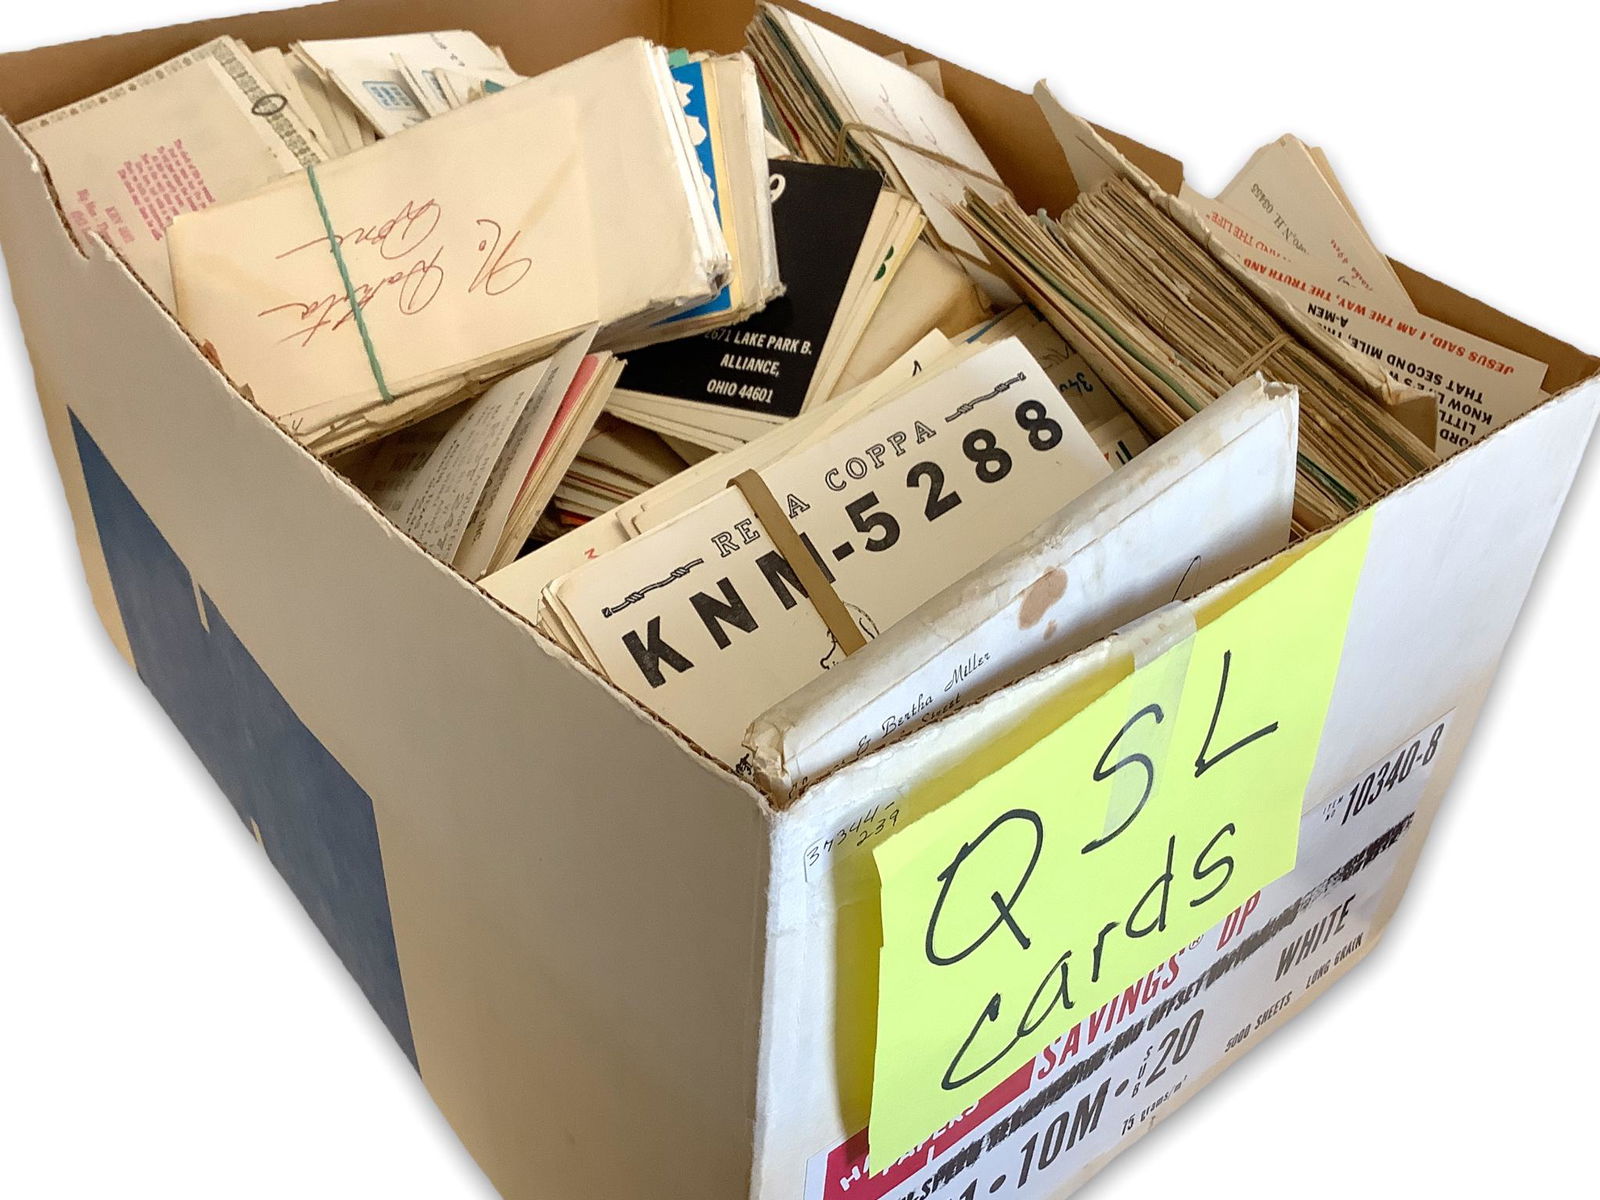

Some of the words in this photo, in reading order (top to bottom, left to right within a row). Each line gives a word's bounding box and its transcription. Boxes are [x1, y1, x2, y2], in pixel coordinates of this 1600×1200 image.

[1233, 225, 1254, 246] THE
[1243, 258, 1268, 275] AND
[1268, 269, 1306, 293] TRUTH
[1311, 284, 1332, 300] THE
[1307, 303, 1349, 327] A-MEN
[1336, 295, 1366, 317] WAY,
[1369, 311, 1395, 327] THE
[1396, 320, 1417, 337] AM
[734, 331, 767, 348] LAKE
[766, 335, 800, 353] PARK
[800, 340, 813, 356] B.
[1348, 334, 1384, 359] MILE,
[1430, 332, 1466, 357] SAID,
[720, 353, 780, 377] ALLIANCE,
[1387, 354, 1443, 386] SECOND
[1467, 352, 1514, 375] JESUS
[706, 378, 738, 397] OHIO
[738, 384, 774, 404] 44601
[1446, 379, 1484, 404] THAT
[1448, 397, 1493, 426] KNOW
[711, 493, 811, 560] REA
[824, 419, 937, 493] COPPA
[881, 695, 934, 738] Bertha
[944, 650, 992, 694] Miller
[1341, 722, 1445, 826] 10340-8
[856, 809, 901, 848] 239
[1217, 890, 1261, 951] DP
[1224, 1023, 1252, 1053] 5000
[1254, 991, 1293, 1030] SHEETS
[1305, 959, 1331, 990] LONG
[1334, 932, 1364, 967] GRAIN
[1017, 1076, 1112, 1189] 10M
[1145, 1008, 1204, 1088] 20
[1275, 893, 1356, 982] WHITE
[1121, 1113, 1136, 1137] 75
